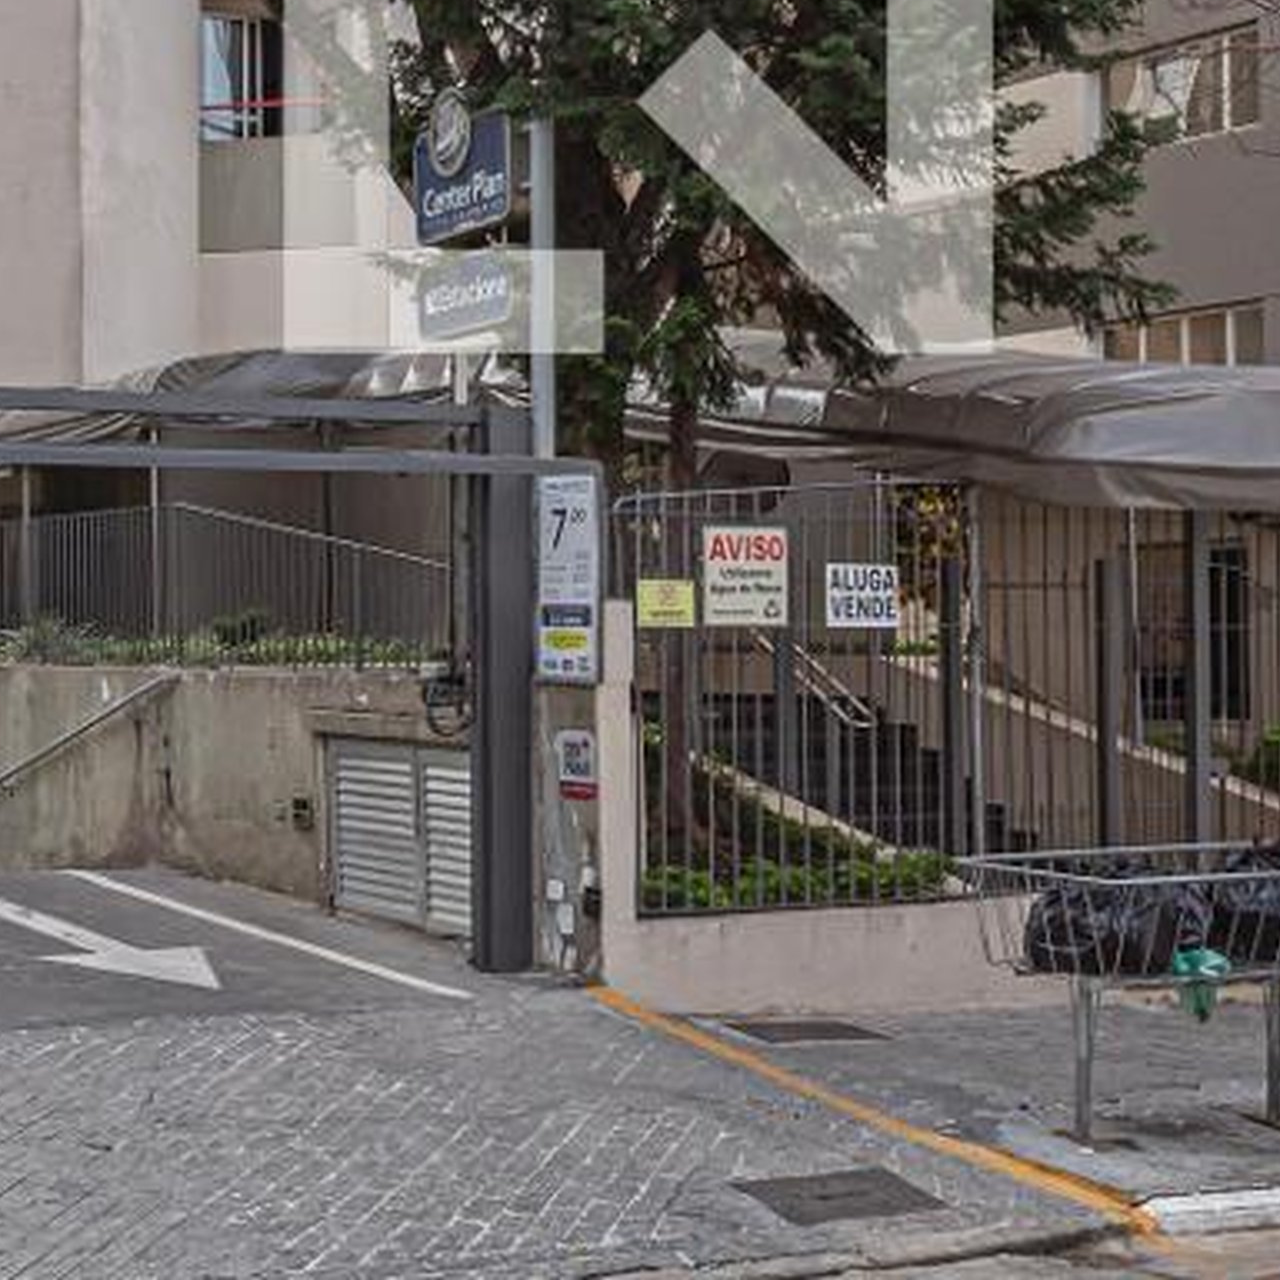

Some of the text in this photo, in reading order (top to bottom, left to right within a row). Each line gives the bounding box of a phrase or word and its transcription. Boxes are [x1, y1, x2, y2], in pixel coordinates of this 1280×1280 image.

[708, 533, 784, 561] AVISO
[830, 568, 894, 592] ALUGA
[830, 595, 897, 619] VENDE
